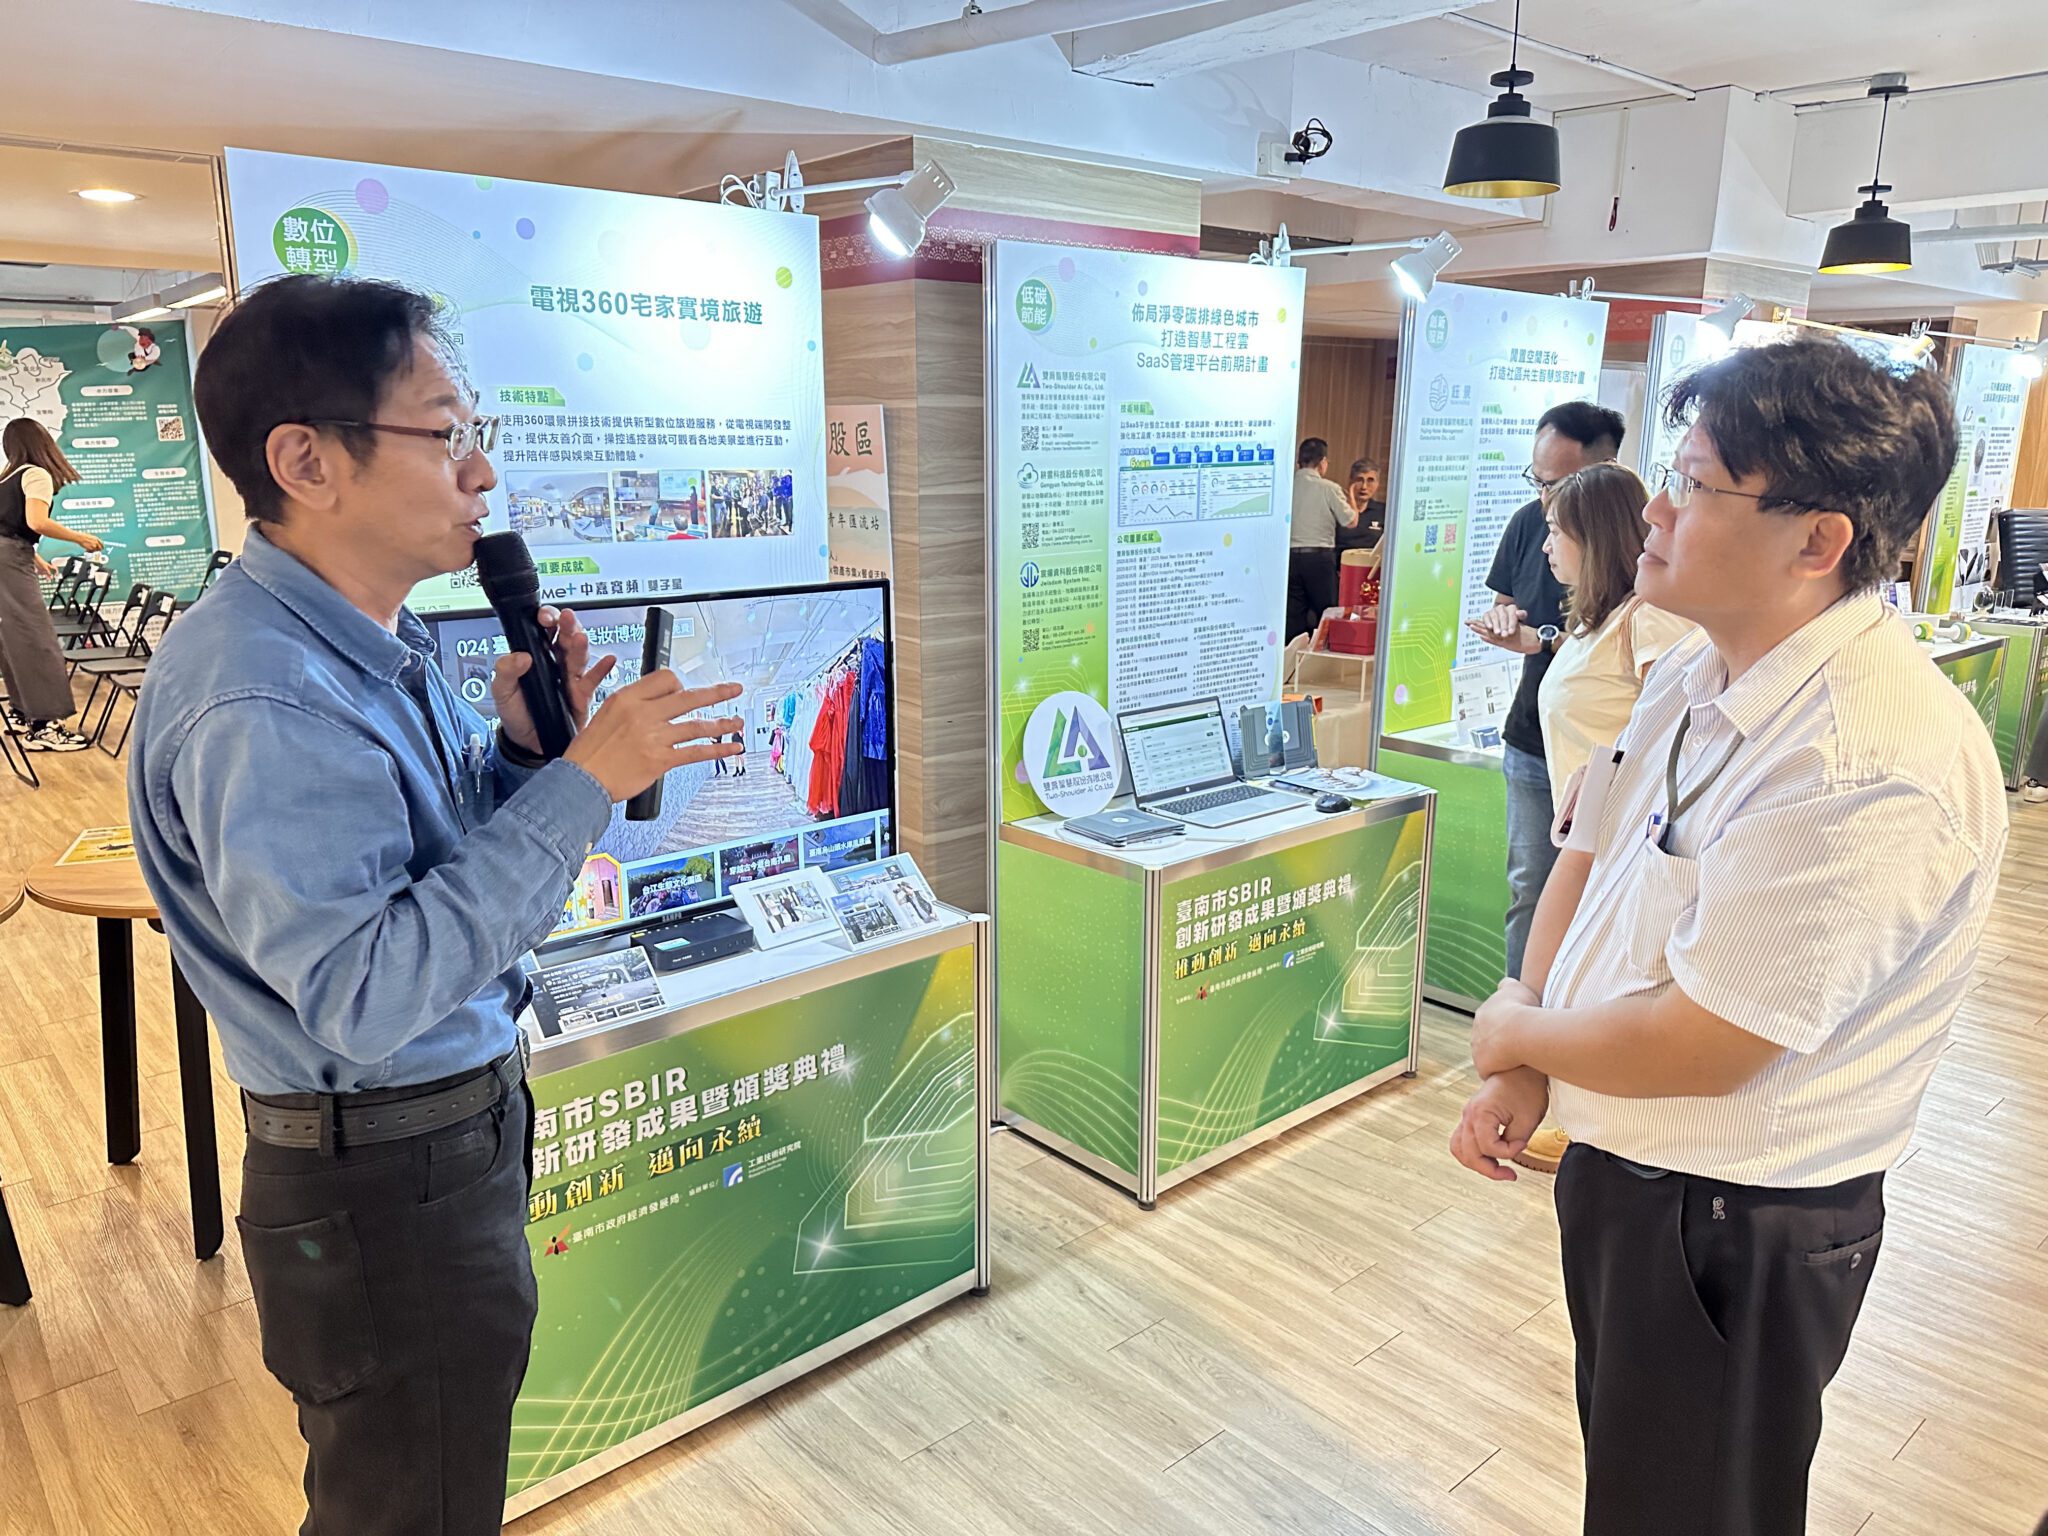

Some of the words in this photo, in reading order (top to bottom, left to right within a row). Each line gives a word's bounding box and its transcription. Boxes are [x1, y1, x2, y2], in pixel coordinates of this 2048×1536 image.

[282, 216, 337, 245] 數位
[286, 246, 338, 273] 轉型
[530, 285, 763, 325] 電視360宅家實境旅遊
[1021, 285, 1048, 305] 低碳
[1021, 307, 1047, 325] 節能
[1132, 303, 1259, 327] 佈局淨零碳排綠色城市
[1161, 328, 1249, 350] 打造智慧工程雲
[1137, 352, 1268, 372] SaaS管理平台前期計畫
[500, 390, 549, 403] 技術特點
[829, 421, 873, 456] 股區
[580, 579, 638, 596] 中嘉寬頻
[648, 578, 682, 592] 雙子星
[1175, 873, 1352, 950] 創新研發成果暨頒獎典禮
[1176, 876, 1272, 925] 臺南市SBIR
[1174, 940, 1238, 980] 推動創新
[1248, 917, 1306, 953] 邁向永續
[532, 1043, 846, 1180] 新研發成果暨頒獎典禮
[534, 1066, 688, 1140] 南市SBIR
[528, 1162, 625, 1223] 動創新
[647, 1114, 762, 1179] 邁向永續
[572, 1193, 680, 1244] 臺南市政府經濟發展局
[748, 1140, 802, 1168] 工業技術研究院
